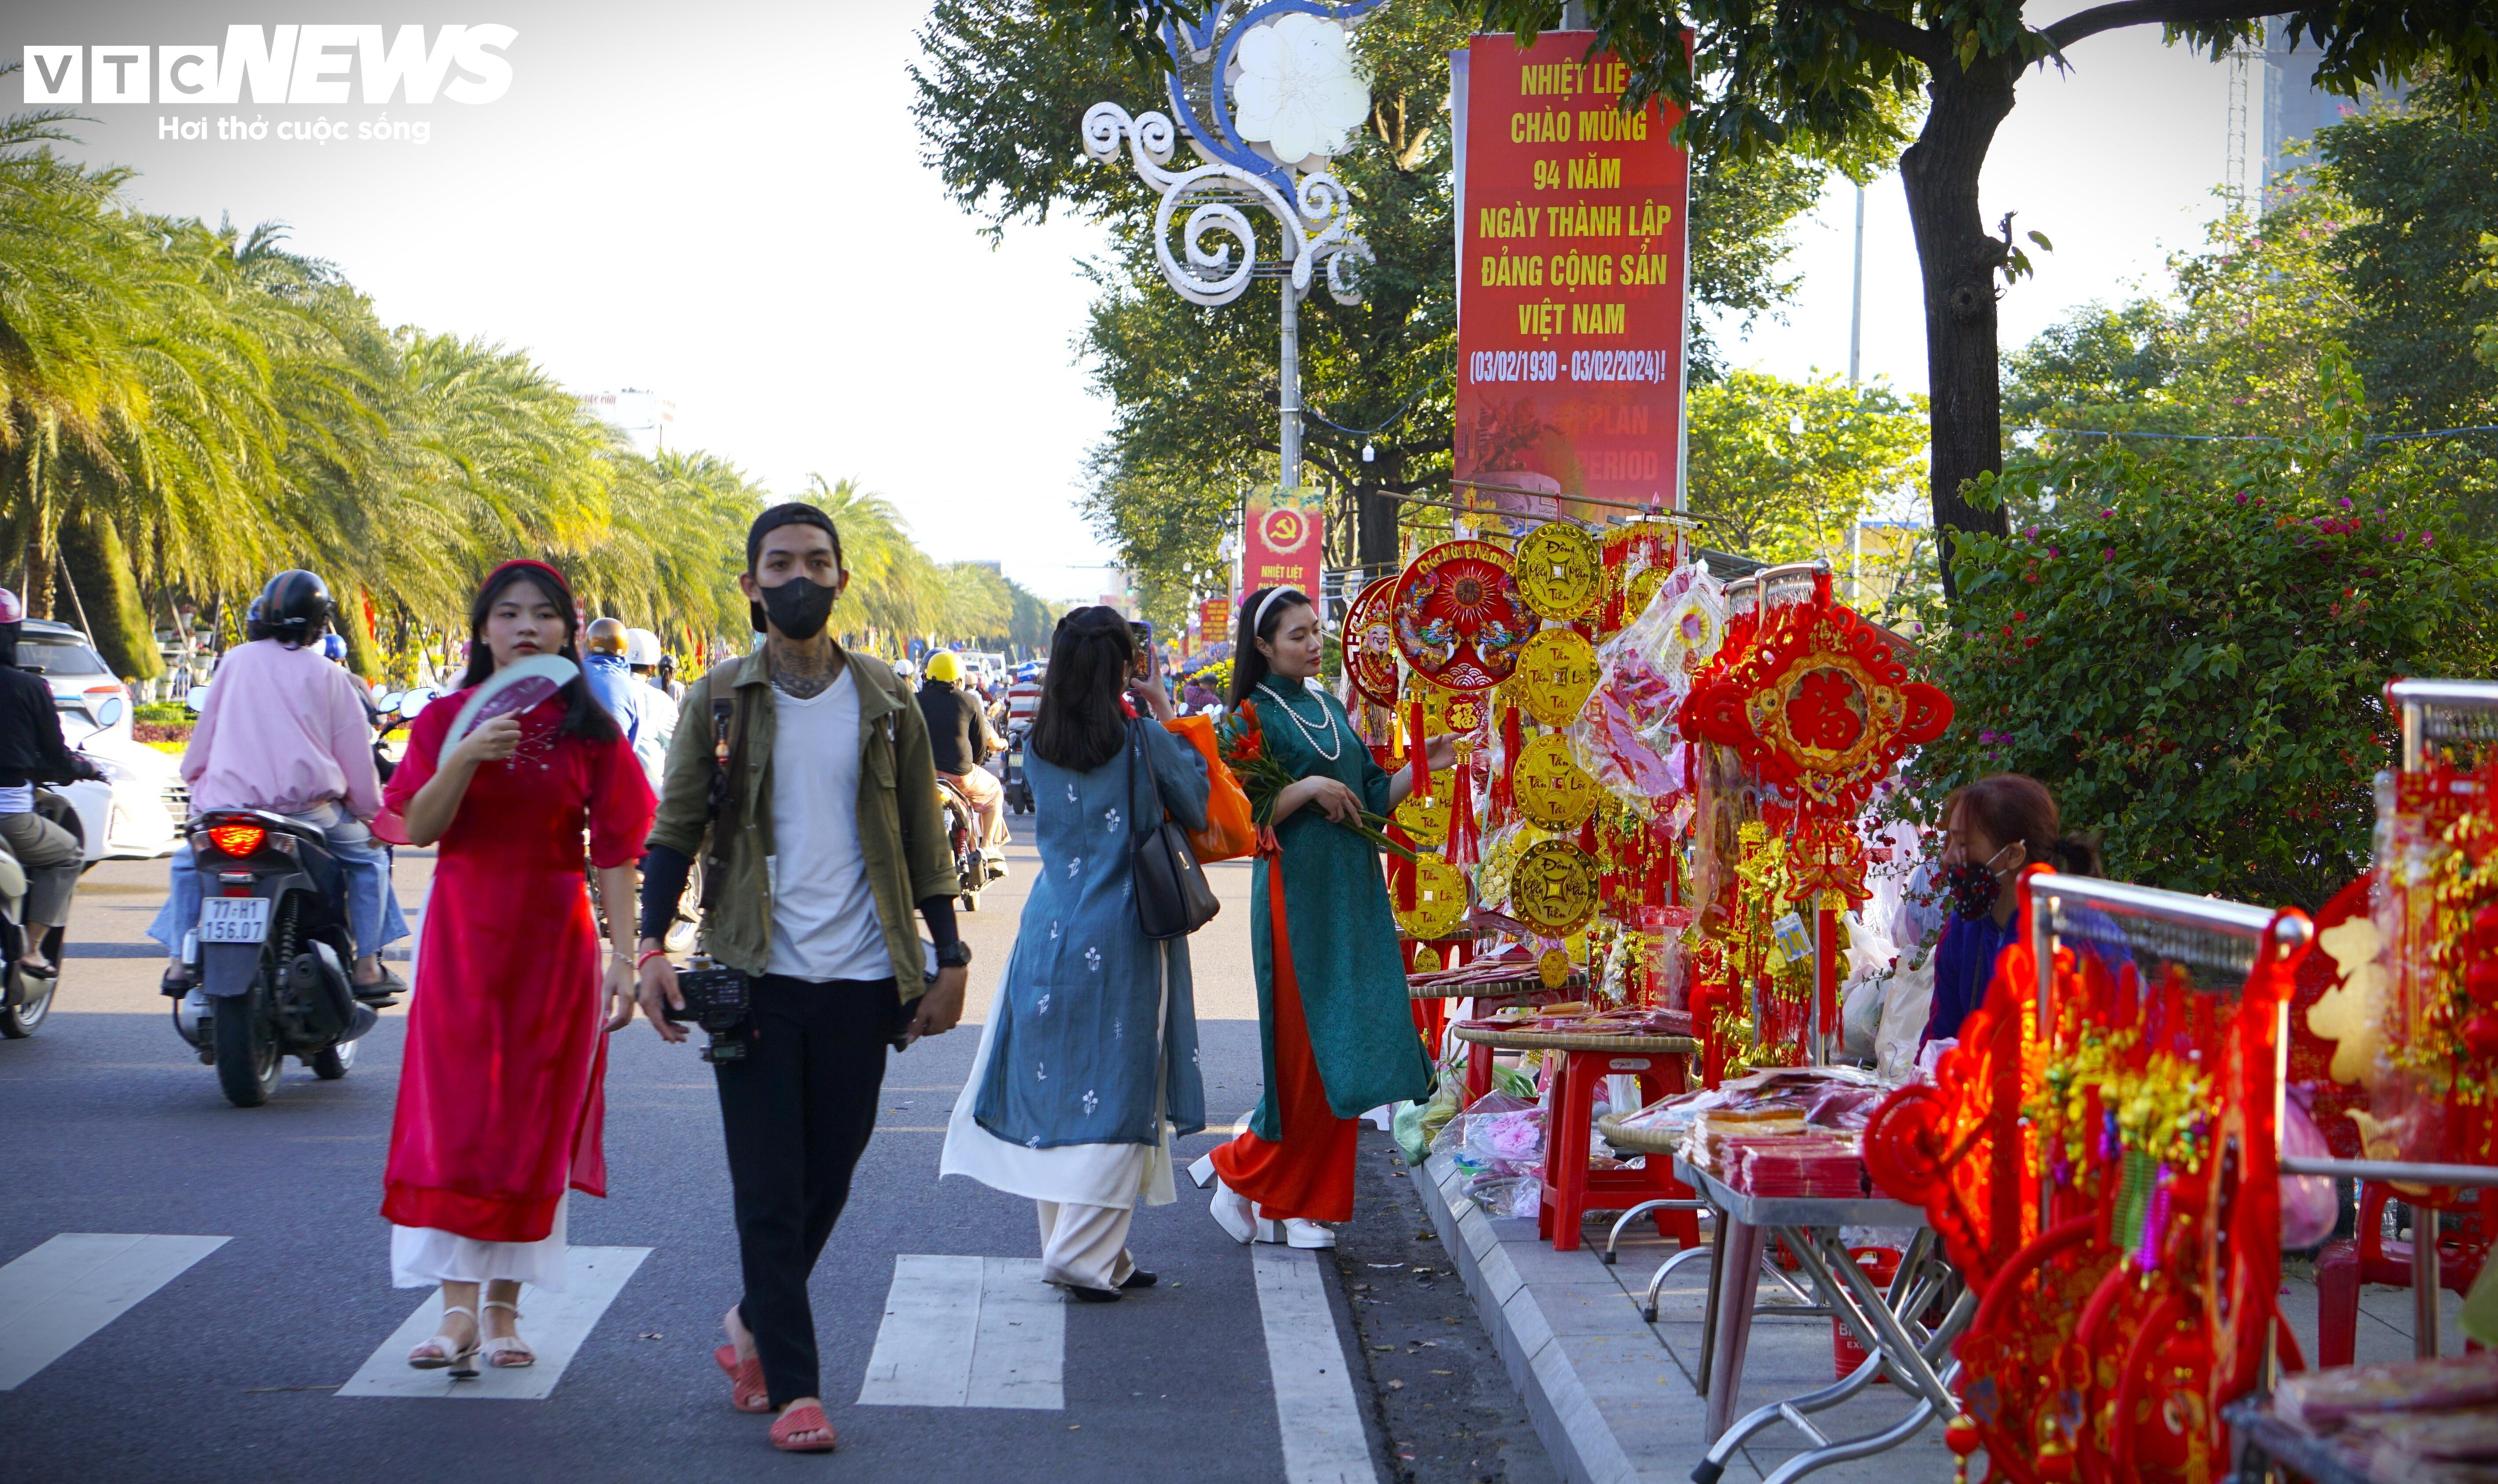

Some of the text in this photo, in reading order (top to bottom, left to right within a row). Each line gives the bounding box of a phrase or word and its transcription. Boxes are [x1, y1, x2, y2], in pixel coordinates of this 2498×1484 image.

[1521, 56, 1633, 101] NHIỆT LIỆ
[1511, 104, 1647, 143] CHÀO MỪNG
[1534, 152, 1621, 190] 94 NĂM
[1480, 201, 1540, 238] NGÀY
[1547, 200, 1622, 237] THÀNH
[1629, 199, 1671, 243] LẬP
[1481, 246, 1542, 287] ĐẢNG
[1550, 248, 1612, 292] CỘNG
[1620, 244, 1667, 285] SẢN
[1519, 297, 1565, 342] VIỆT
[1572, 304, 1625, 334] NAM
[1470, 351, 1557, 384] (03/02/1930
[1571, 350, 1666, 384] 03/02/2024)!
[1417, 553, 1443, 575] Chúc
[1440, 544, 1472, 561] Mừng
[1473, 544, 1502, 564] Năm
[1545, 540, 1575, 565] Đồng
[1261, 564, 1303, 581] NHIỆT LIỆT
[1548, 588, 1570, 601] Tiền
[1550, 646, 1570, 661] Tấn
[1529, 668, 1587, 684] Tấn Lộc
[1550, 695, 1568, 709] Tài
[1451, 702, 1478, 729] 福
[1548, 752, 1569, 767] Tấn
[1527, 774, 1586, 791] Tấn Lộc
[1548, 801, 1567, 815] Tài
[1421, 816, 1439, 829] Tiền
[1829, 846, 1847, 866] 福
[1421, 868, 1440, 881] Tấn
[1541, 858, 1573, 882] Đồng
[1440, 890, 1454, 902] Lộc
[1420, 911, 1437, 924] Tài
[1543, 906, 1566, 919] Tiền
[206, 921, 262, 939] 156.07
